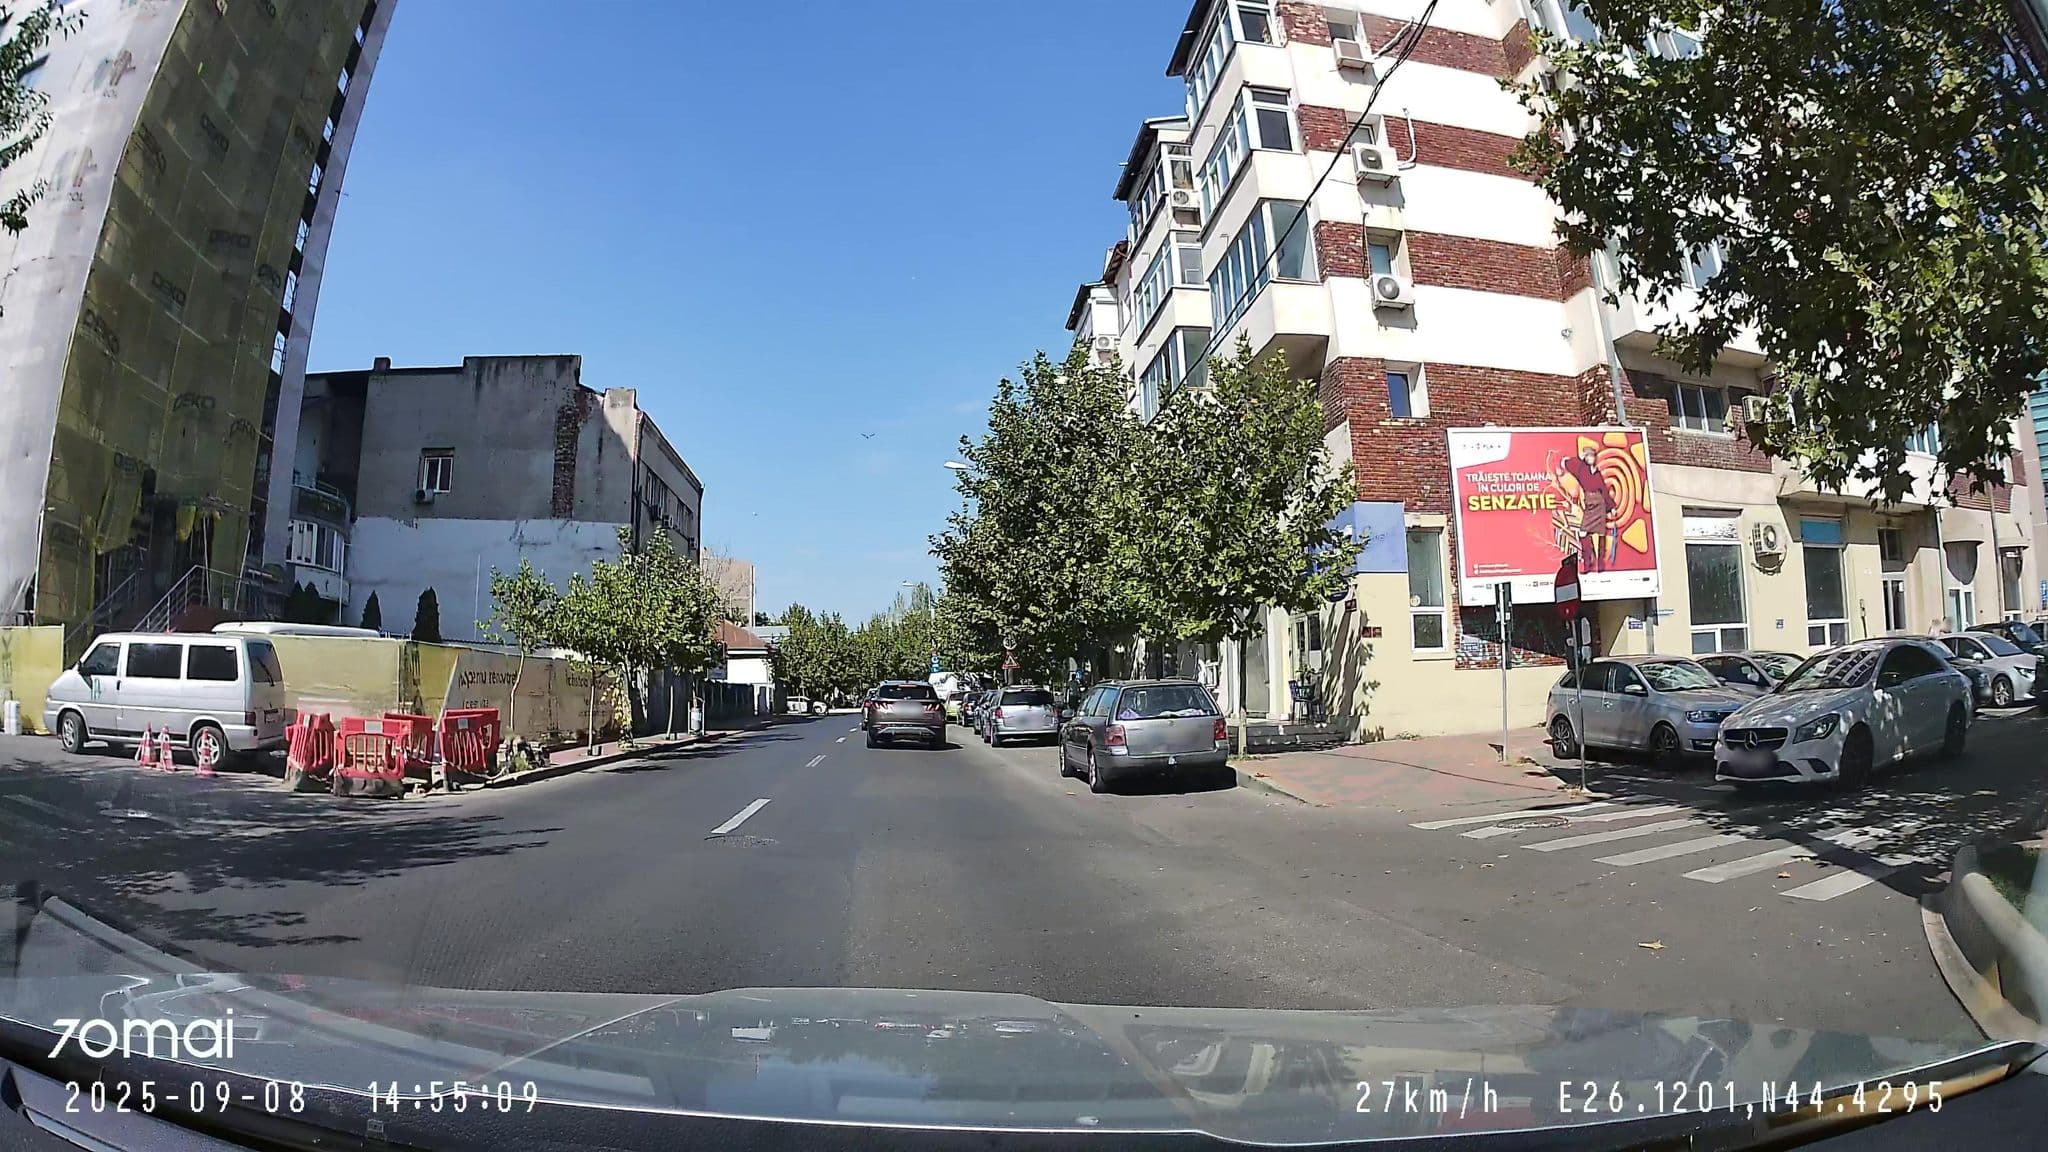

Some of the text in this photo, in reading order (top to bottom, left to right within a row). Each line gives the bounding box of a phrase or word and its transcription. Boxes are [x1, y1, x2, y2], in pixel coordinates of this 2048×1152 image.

[1511, 471, 1552, 481] TOAMNA
[1478, 482, 1540, 493] ÎN CULORI DE
[1468, 493, 1557, 515] SENZAȚIE
